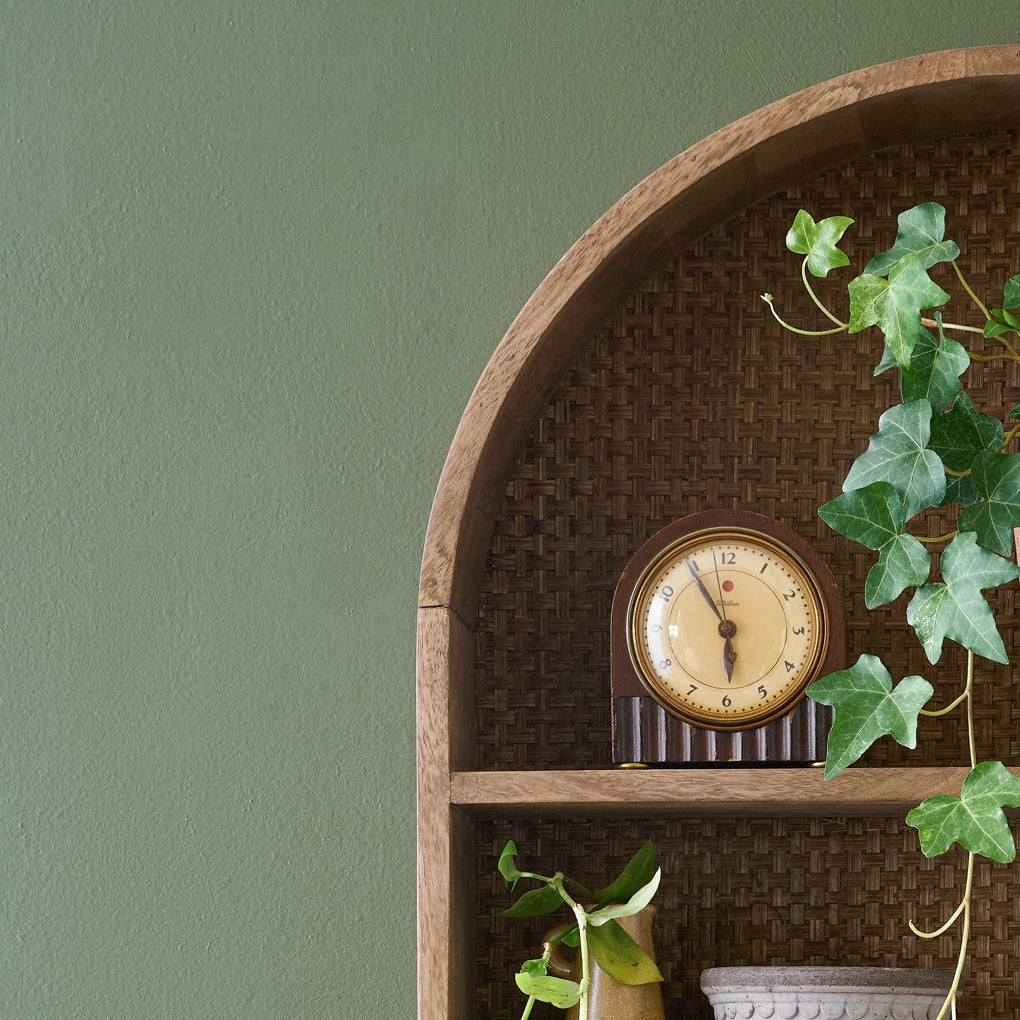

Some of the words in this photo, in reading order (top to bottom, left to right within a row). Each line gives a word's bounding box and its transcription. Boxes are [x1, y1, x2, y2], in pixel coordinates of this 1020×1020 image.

[721, 552, 736, 565] 12
[759, 562, 769, 574] 1
[659, 585, 674, 602] 10
[782, 588, 796, 601] 2
[651, 624, 663, 634] 9
[792, 625, 805, 636] 3
[659, 658, 672, 670] 8
[783, 660, 795, 673] 4
[686, 684, 699, 696] 7
[757, 684, 768, 699] 5
[721, 695, 732, 707] 6
